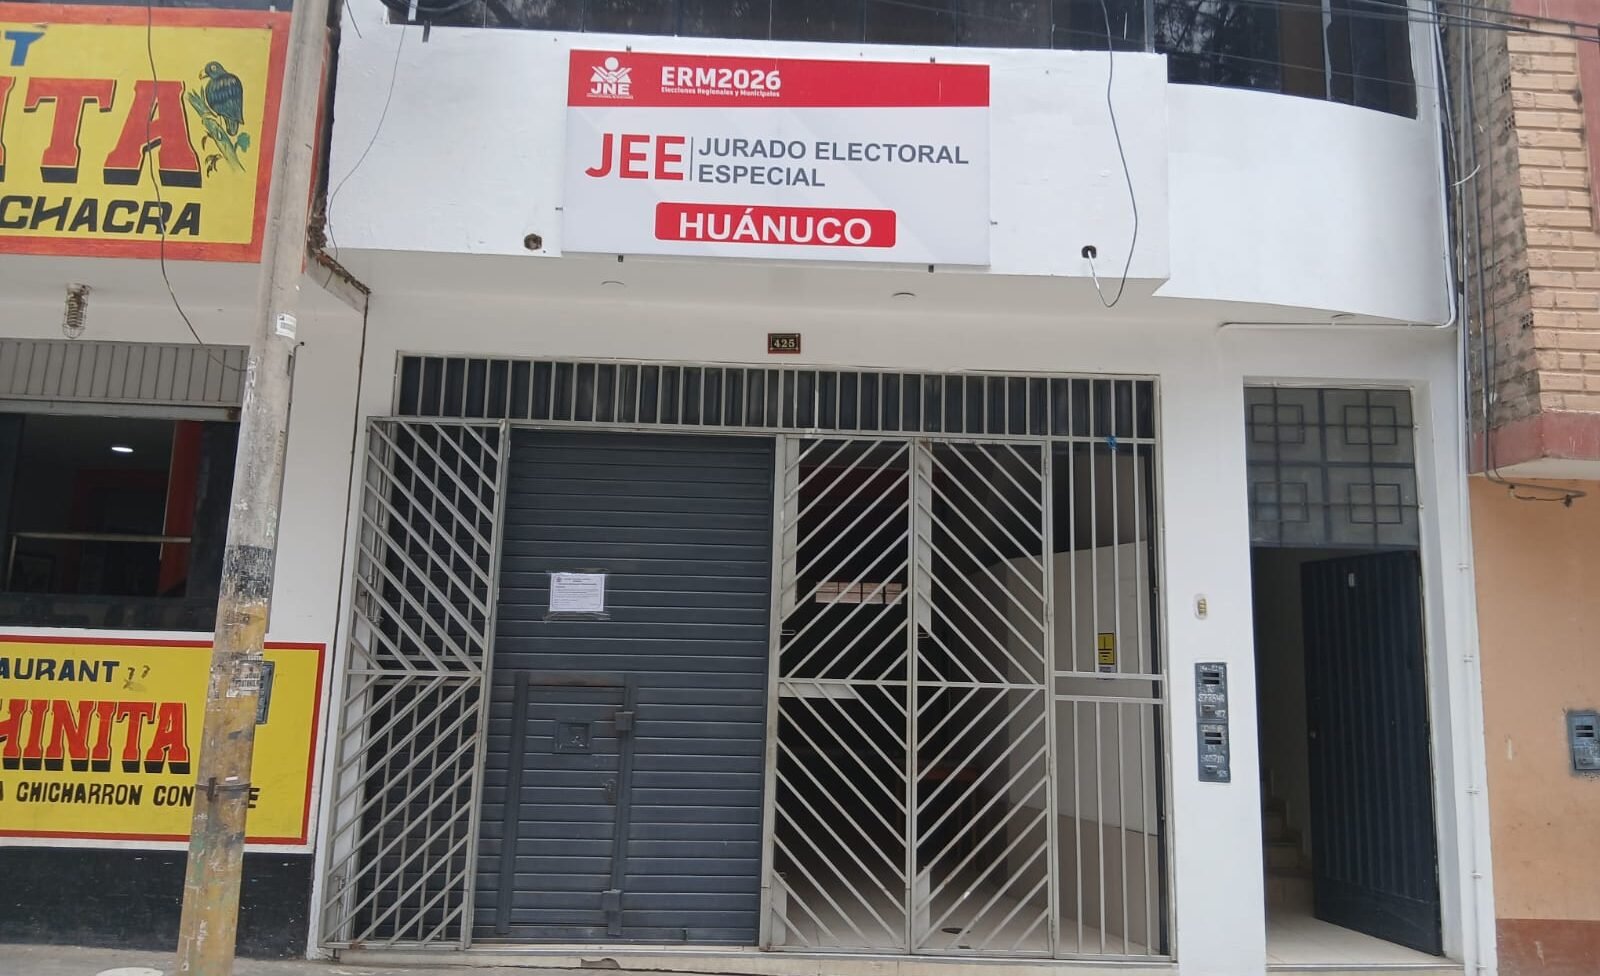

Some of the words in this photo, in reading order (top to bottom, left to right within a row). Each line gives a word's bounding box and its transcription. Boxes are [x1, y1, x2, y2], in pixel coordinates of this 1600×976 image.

[591, 82, 630, 96] JNE
[661, 66, 781, 90] ERM2026
[661, 86, 696, 94] Elecciones
[698, 87, 733, 97] Regionales
[735, 89, 739, 97] y
[740, 90, 780, 98] Municipales
[585, 133, 685, 181] JEE
[699, 137, 806, 159] JURADO
[815, 141, 969, 164] ELECTORAL
[699, 164, 825, 187] ESPECIAL
[0, 195, 201, 236] CHACRA
[679, 208, 872, 245] HUÁNUCO
[773, 338, 796, 348] 425
[16, 781, 143, 806] CHICHARRON
[153, 785, 194, 807] CON
